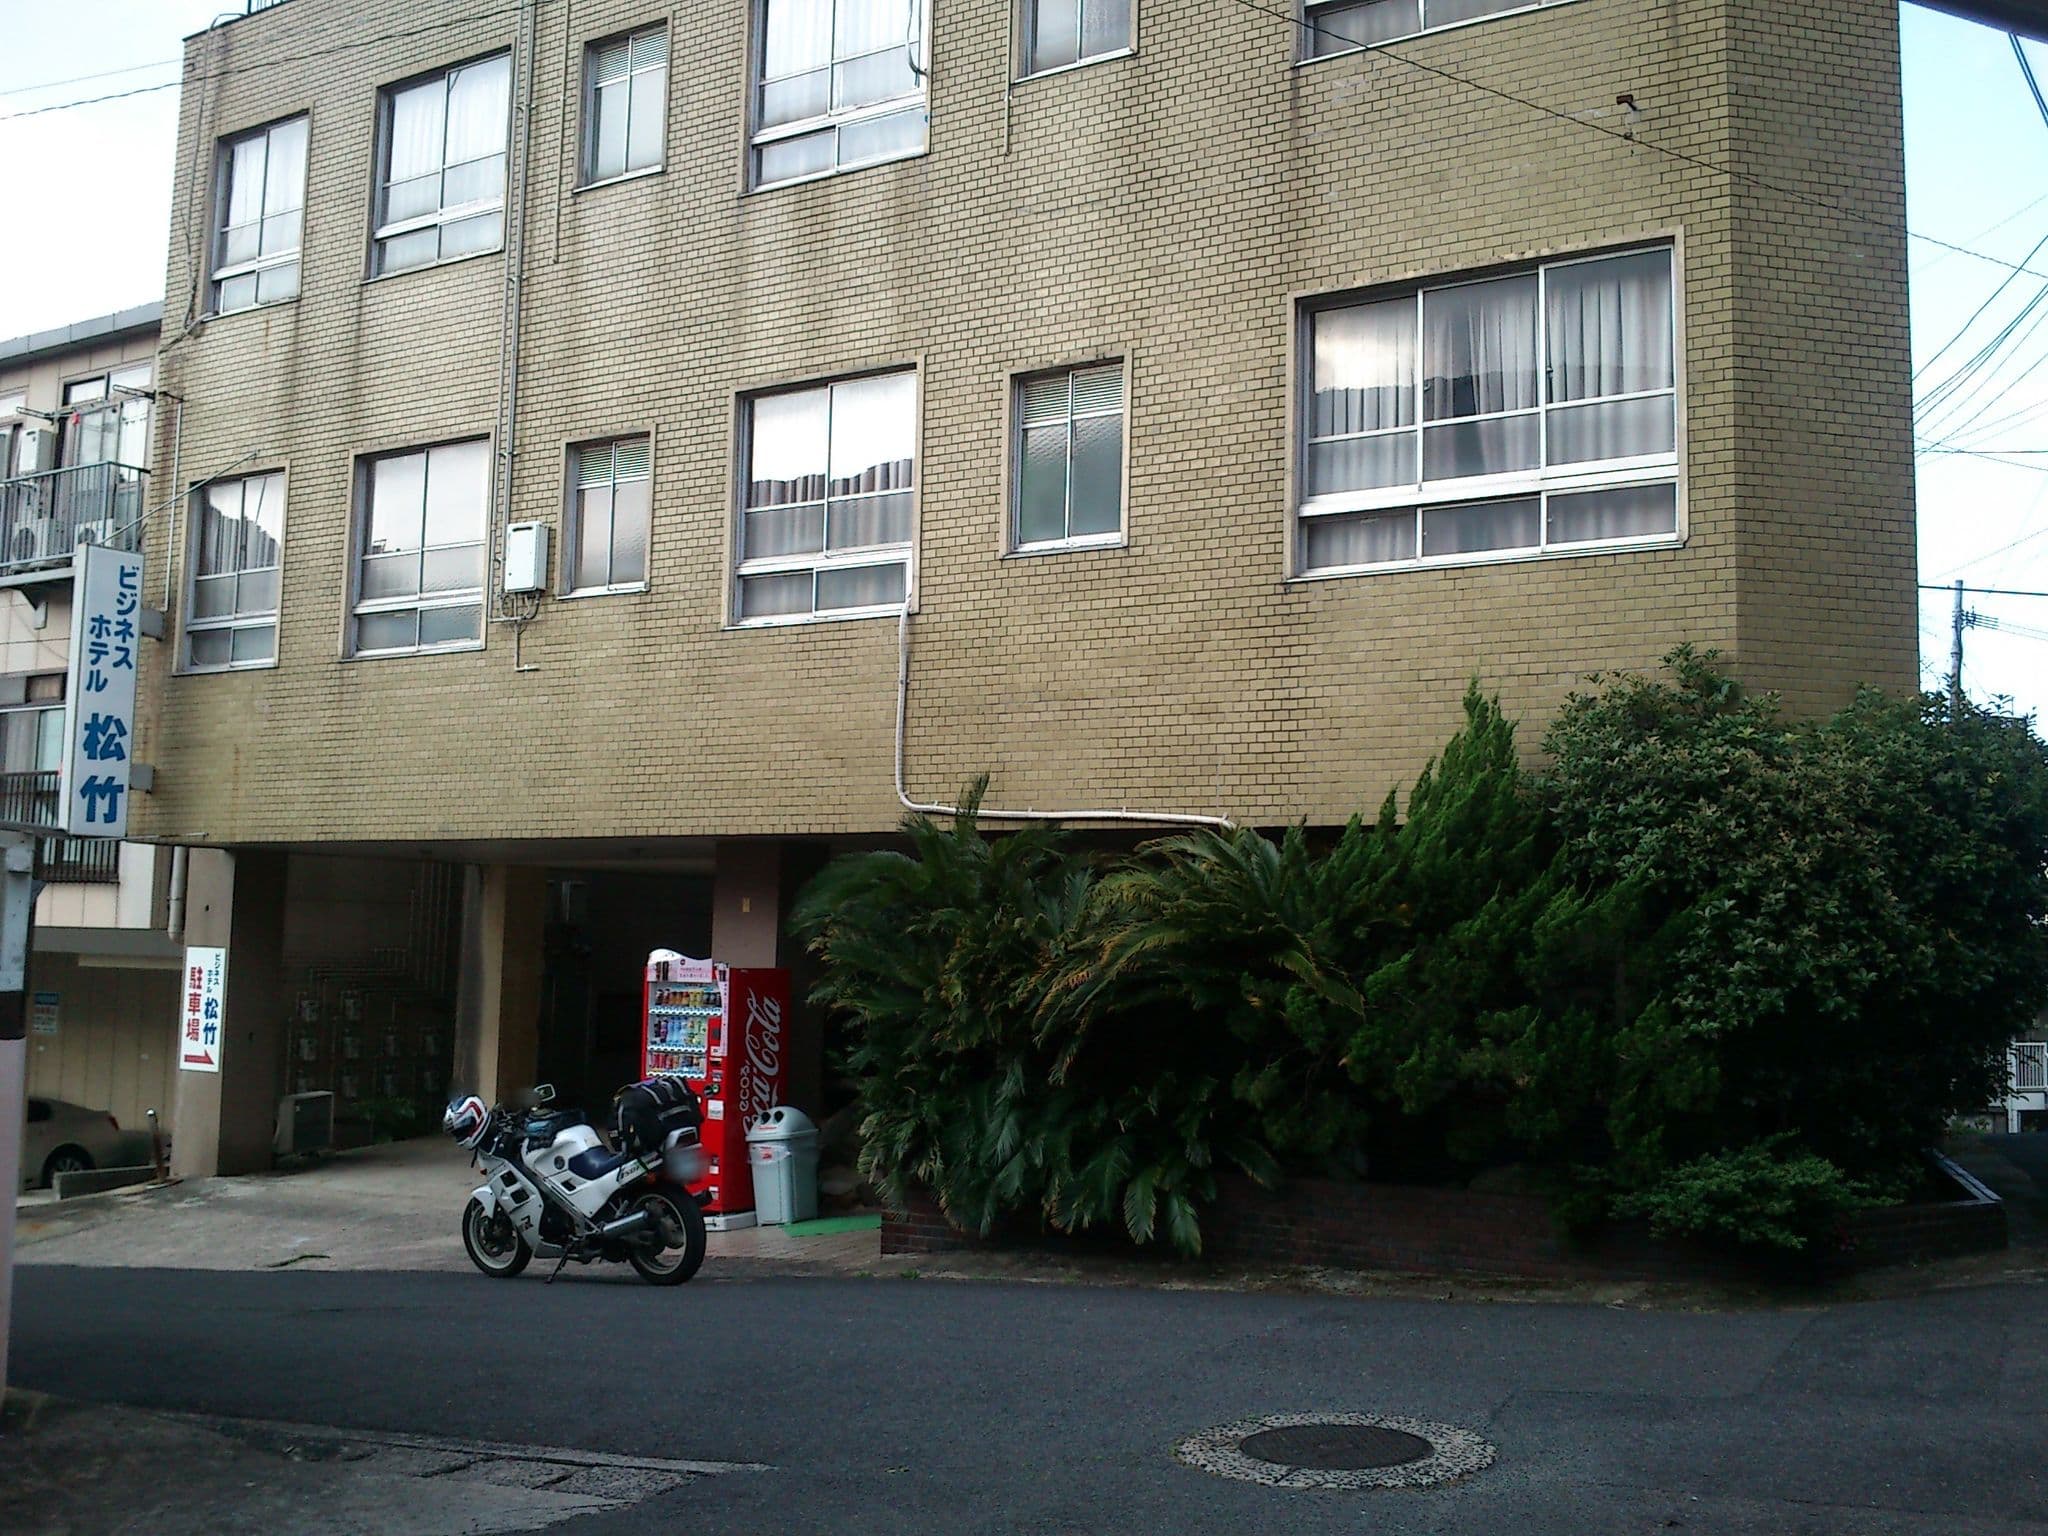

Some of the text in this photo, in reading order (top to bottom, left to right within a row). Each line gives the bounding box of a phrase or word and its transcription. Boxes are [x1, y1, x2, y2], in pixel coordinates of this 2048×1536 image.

[85, 614, 111, 692] ホテル
[112, 564, 140, 670] ビジネス
[79, 712, 128, 824] 松竹
[186, 966, 203, 1042] 駐車場
[204, 997, 218, 1045] 松竹
